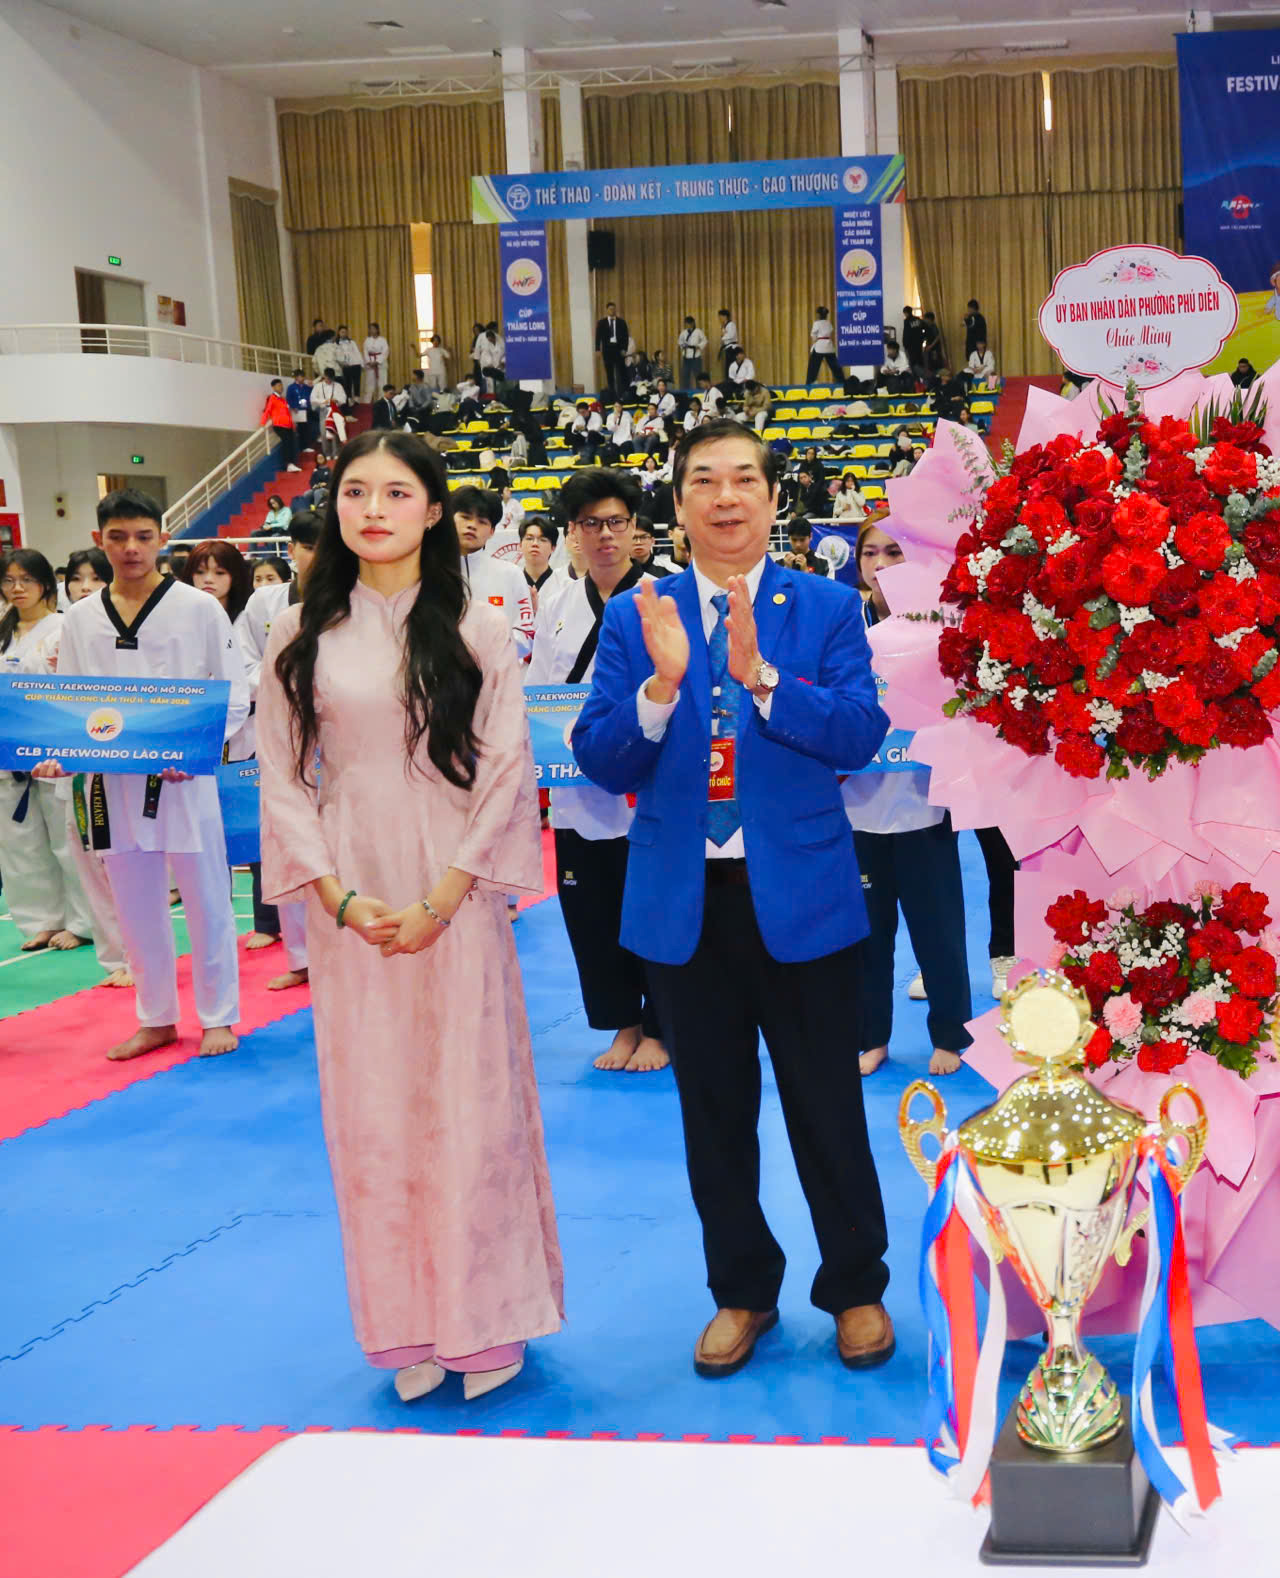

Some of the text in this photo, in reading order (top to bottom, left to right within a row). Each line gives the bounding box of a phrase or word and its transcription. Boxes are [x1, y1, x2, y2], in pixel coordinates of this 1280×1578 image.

[535, 180, 557, 205] THỂ
[560, 185, 591, 204] THAO
[640, 176, 662, 200] KẾT
[675, 178, 714, 198] TRUNG
[719, 176, 749, 199] THỰC
[762, 175, 786, 193] CAO
[790, 171, 838, 195] THƯỢNG
[1070, 302, 1088, 322] BAN
[1090, 296, 1115, 320] NHÂN
[1118, 294, 1136, 318] DÂN
[1138, 290, 1175, 317] PHƯỜNG
[1177, 288, 1195, 314] PHÚ
[1198, 283, 1219, 312] DIỄN
[853, 310, 867, 321] CÚP
[529, 321, 545, 330] LONG
[841, 324, 879, 334] THĂNG LONG
[1106, 324, 1172, 348] Chúc Mừng
[12, 681, 206, 695] FESTIVAL TAEKWONDO HÀ NỘI MỞ RỘNG
[527, 705, 549, 713] HĂNG
[551, 705, 573, 713] LONG
[15, 746, 184, 760] CLB TAEKWONDO LÀO CAI
[240, 768, 260, 778] FEST
